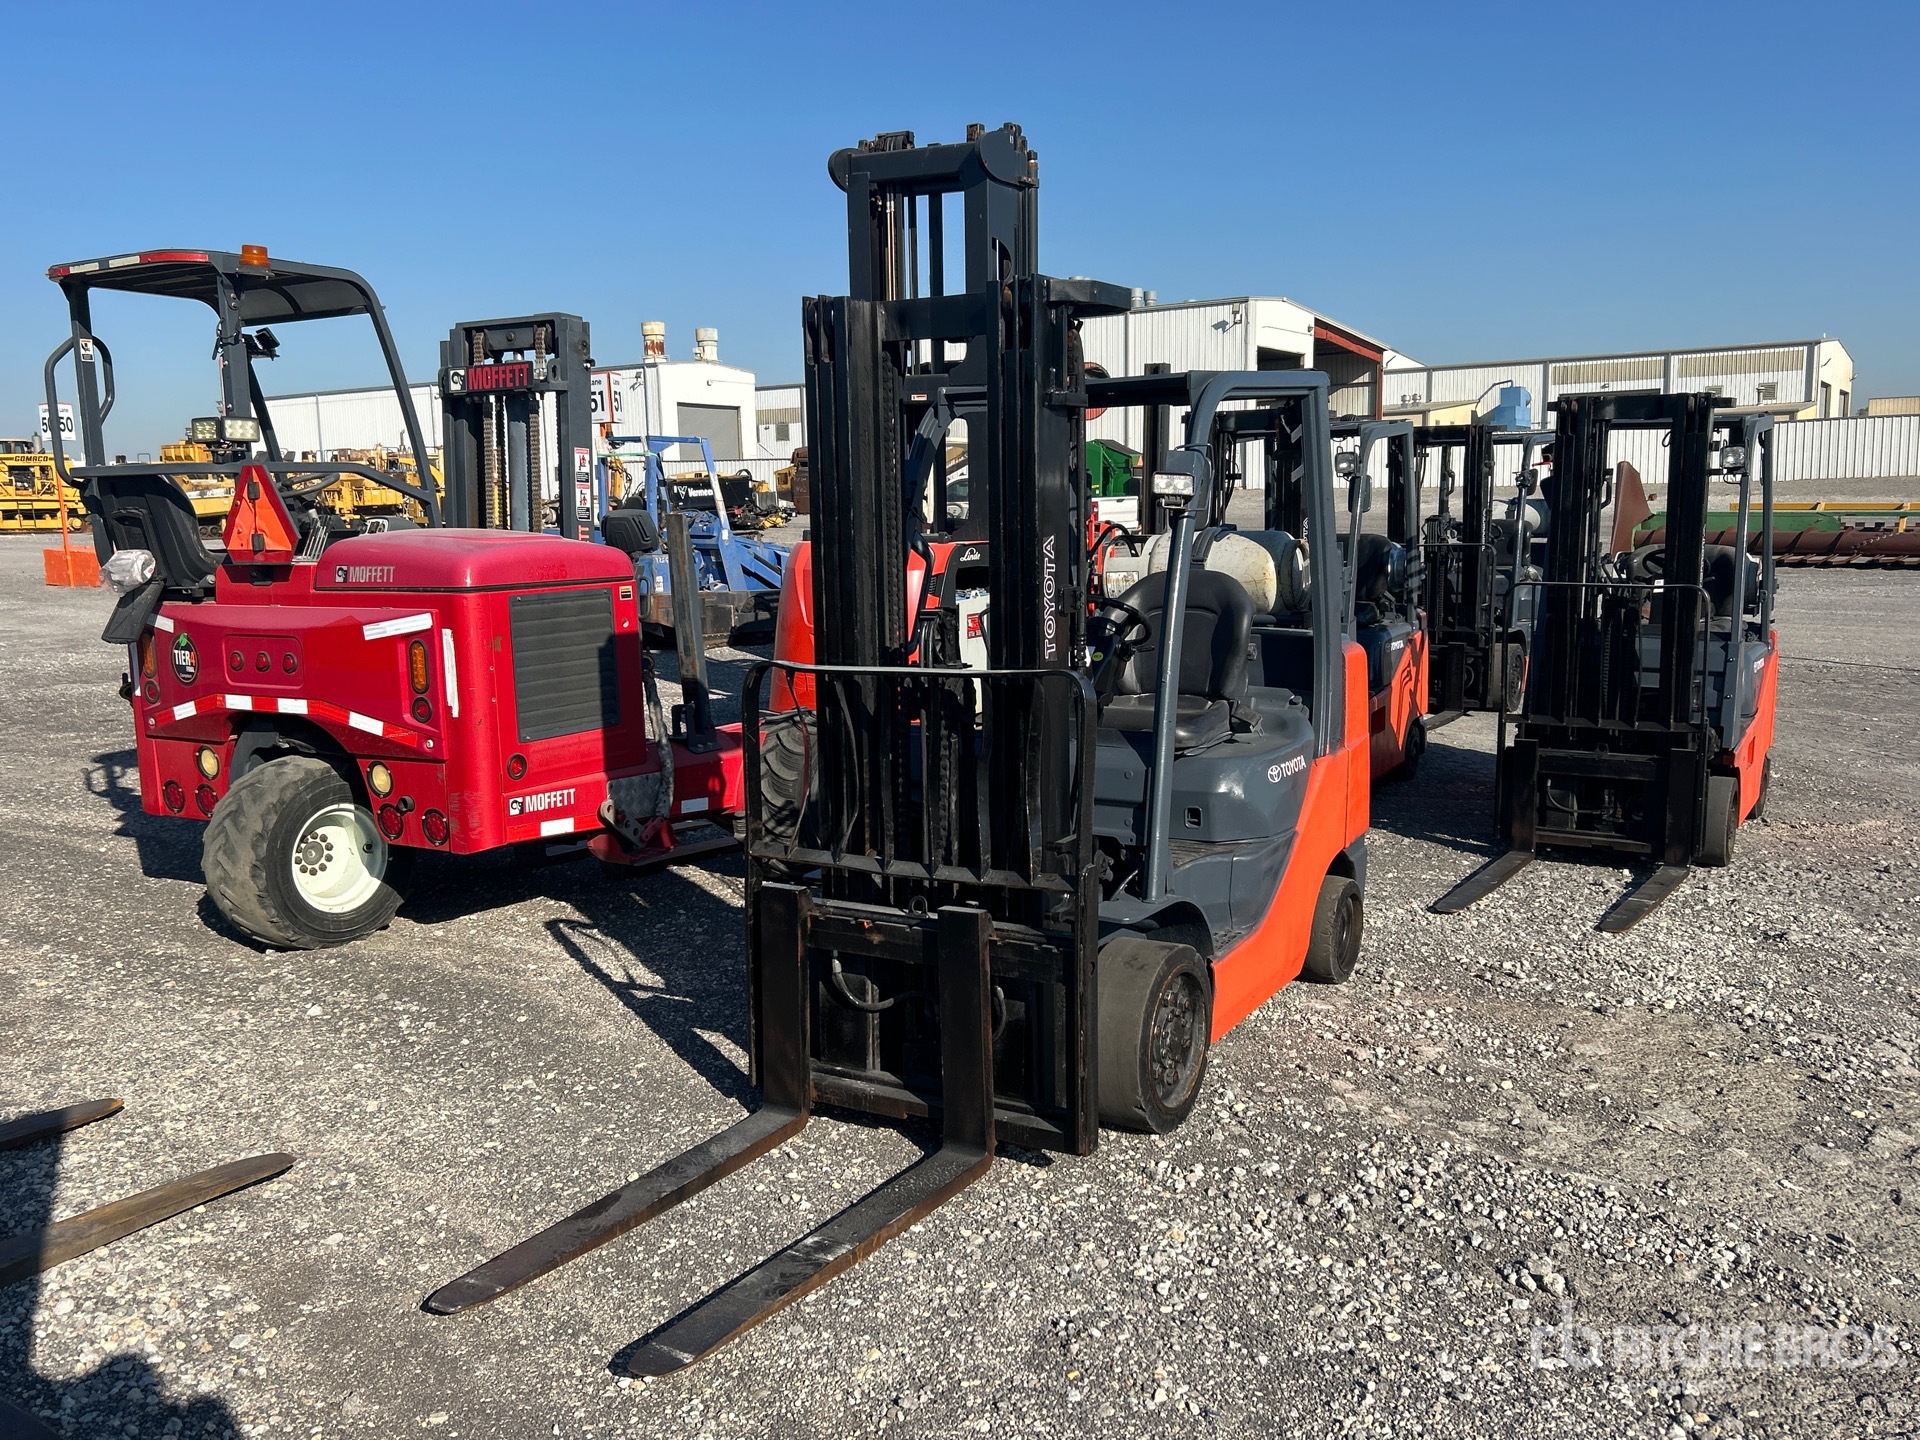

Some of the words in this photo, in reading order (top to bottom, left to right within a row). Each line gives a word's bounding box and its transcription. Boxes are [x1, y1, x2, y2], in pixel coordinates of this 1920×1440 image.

[468, 364, 529, 390] MOFFETT
[591, 390, 605, 413] 51
[613, 390, 622, 413] 51
[41, 417, 52, 433] 5
[59, 416, 74, 433] 50
[688, 487, 714, 498] Vermee
[960, 547, 981, 562] Linde
[349, 566, 396, 583] MOFFETT
[1043, 535, 1056, 659] TOYOTA
[1280, 754, 1307, 778] TOYOTA
[525, 788, 576, 813] MOFFETT
